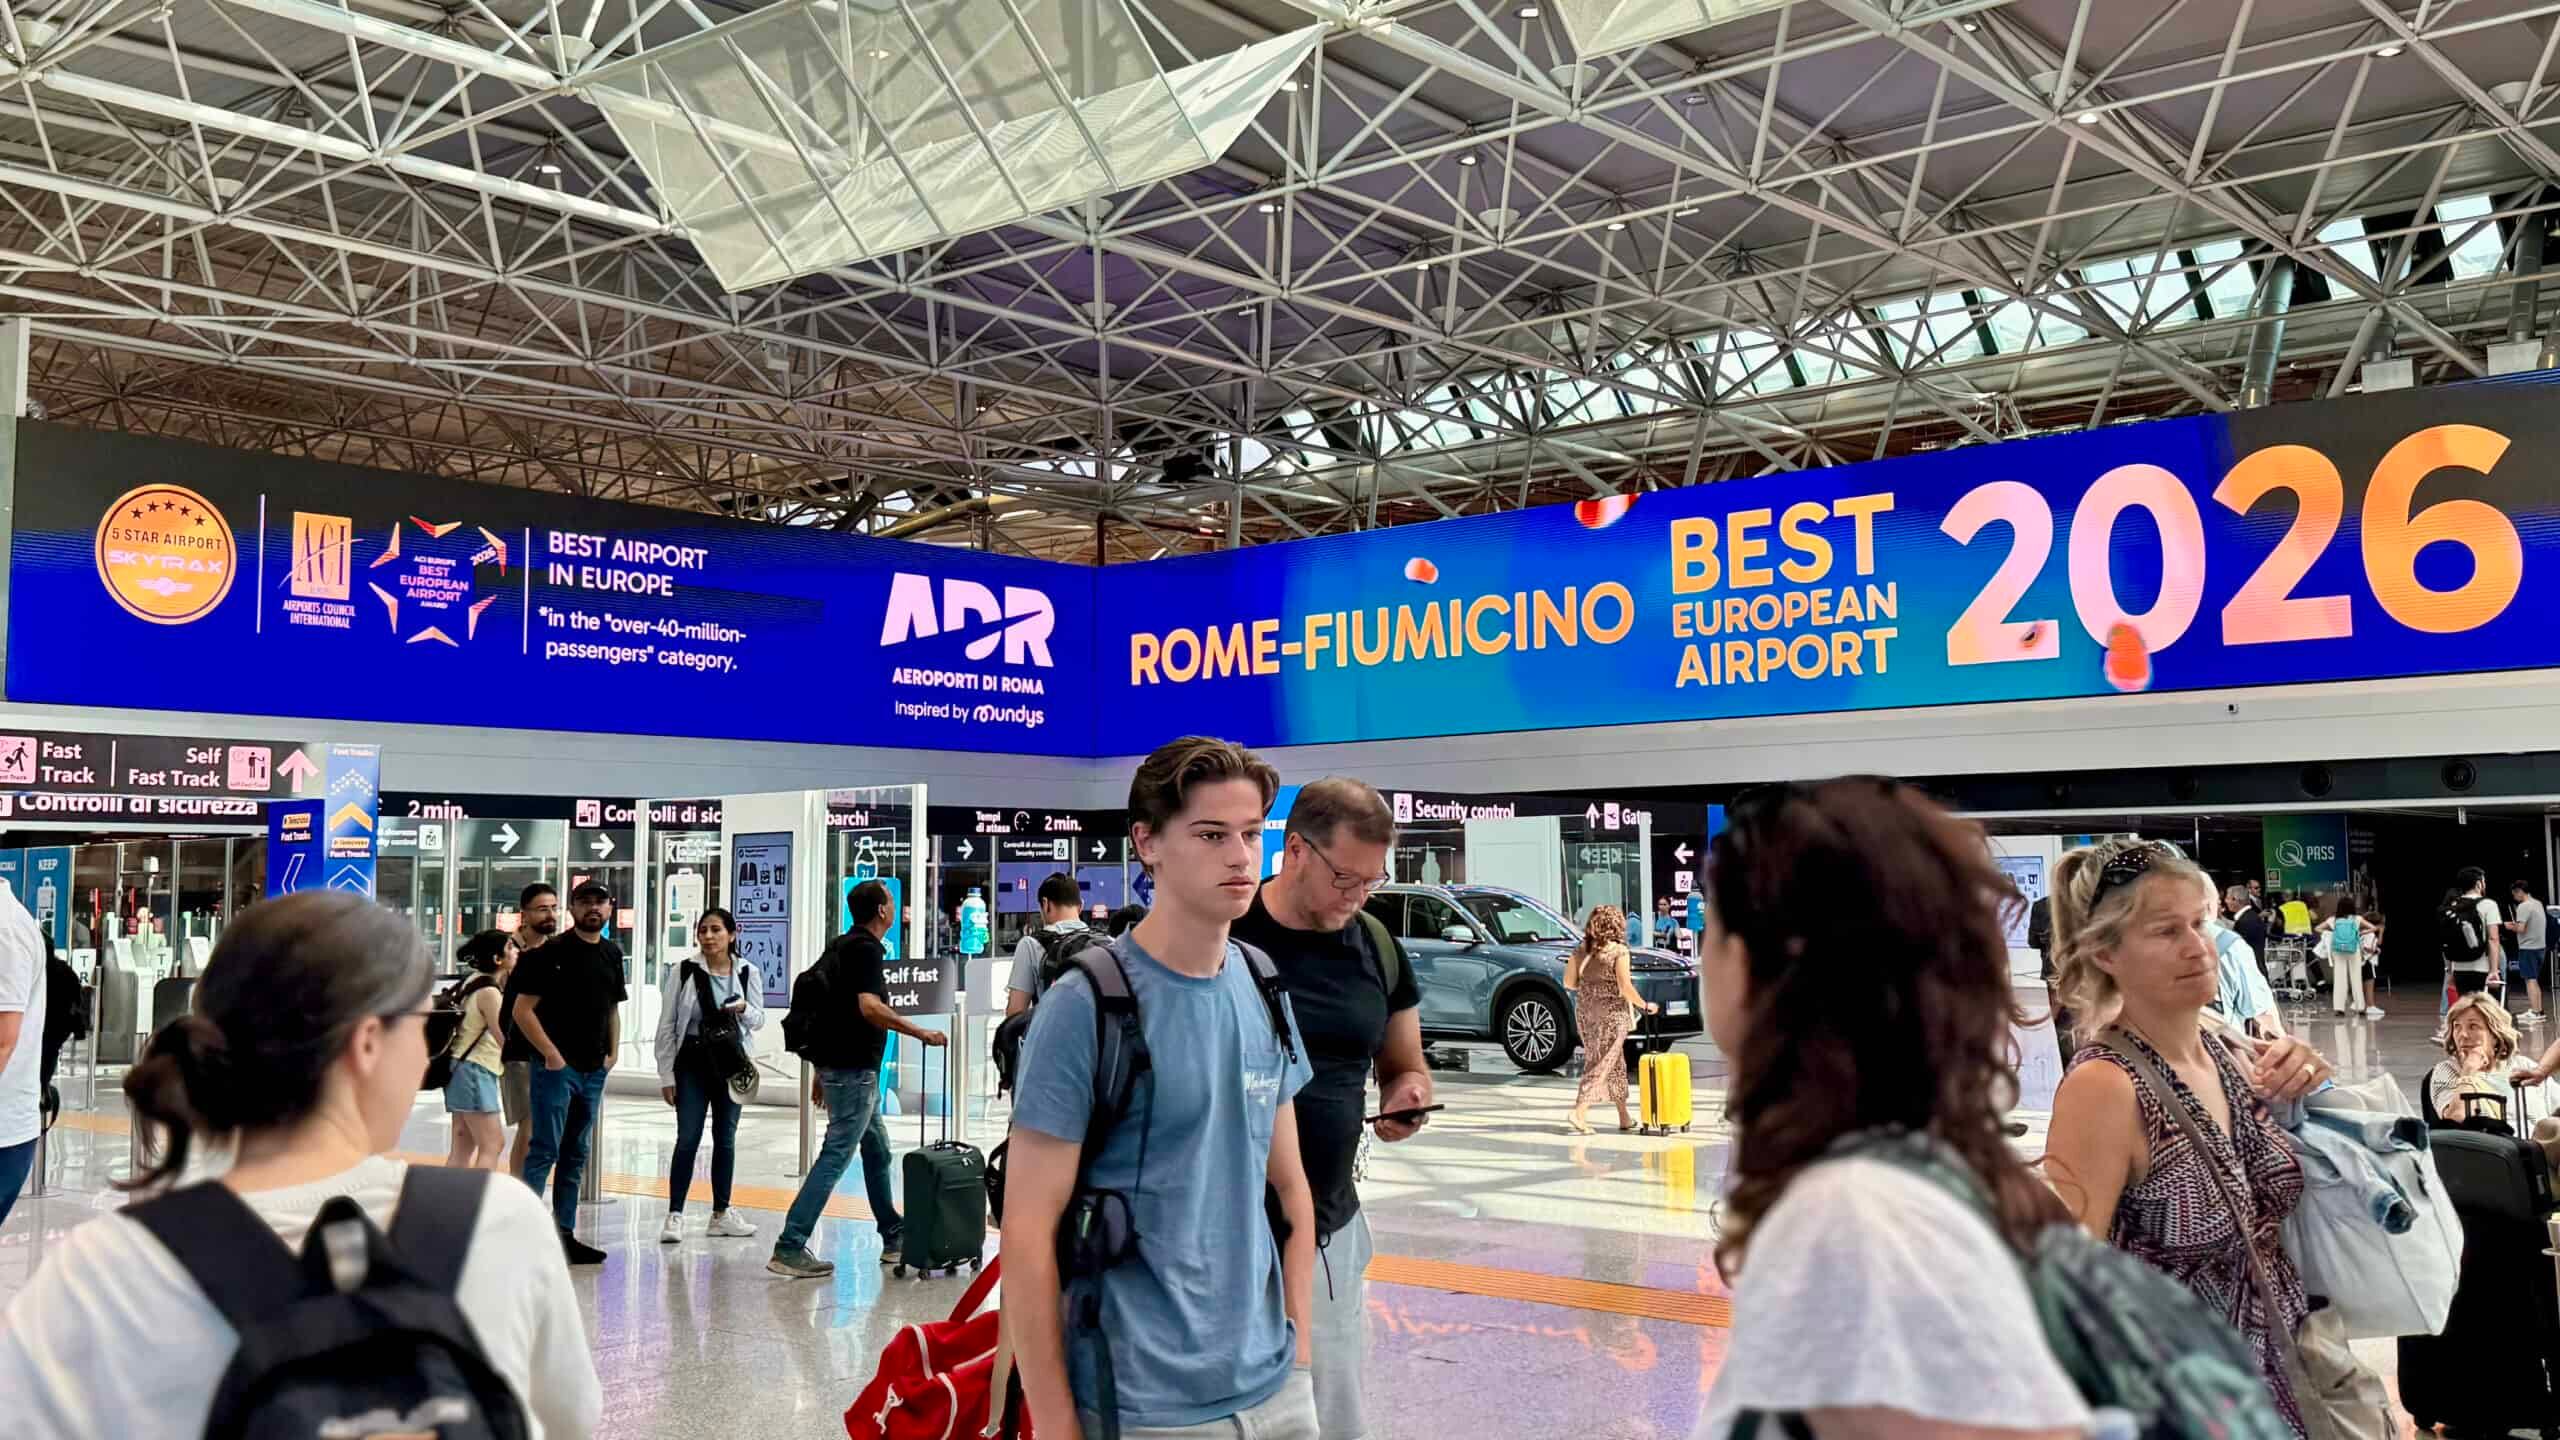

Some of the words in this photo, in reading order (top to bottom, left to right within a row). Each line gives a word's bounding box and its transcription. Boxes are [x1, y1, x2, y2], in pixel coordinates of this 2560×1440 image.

[111, 527, 120, 540] 5
[124, 528, 160, 544] STAR
[163, 534, 223, 550] AIRPORT
[1668, 493, 1896, 595] BEST
[1940, 423, 2524, 667] 2026
[295, 519, 346, 586] ACI
[549, 531, 606, 558] BEST
[611, 539, 708, 570] AIRPORT
[108, 550, 224, 574] SKYTRAX
[418, 565, 450, 577] BEST
[399, 574, 470, 592] EUROPEAN
[548, 562, 574, 587] IN
[582, 566, 674, 597] EUROPE
[406, 587, 462, 602] AIRPORT
[282, 599, 321, 614] AIRPORTS
[1672, 581, 1899, 639] EUROPEAN
[290, 612, 352, 628] INTERNATIONAL
[569, 611, 601, 631] the
[880, 572, 1055, 667] ADR
[1130, 580, 1636, 686] ROME-FIUMICINO
[545, 640, 654, 665] passengers"
[657, 649, 738, 674] category.
[1675, 627, 1899, 690] AIRPORT
[892, 667, 979, 691] AEROPORTI
[982, 675, 998, 692] DI
[1001, 677, 1045, 695] ROMA
[895, 700, 950, 720] Inspired
[952, 703, 970, 723] by
[42, 741, 82, 760] Fast
[185, 747, 223, 764] Self
[40, 766, 95, 784] Track
[128, 769, 167, 786] Fast
[171, 770, 221, 787] Track
[19, 795, 123, 813] Controlli
[130, 796, 152, 813] di
[158, 798, 258, 815] sicurezza
[407, 800, 420, 818] 2
[423, 800, 469, 819] min.
[604, 804, 676, 823] Conrolli
[680, 805, 697, 823] di
[1415, 799, 1468, 825] Security
[1471, 802, 1515, 819] control
[1044, 815, 1053, 831] 2
[1053, 815, 1083, 831] min.
[2306, 845, 2335, 861] PASS
[882, 967, 910, 984] Self
[912, 966, 939, 983] fast
[888, 989, 919, 1007] rack
